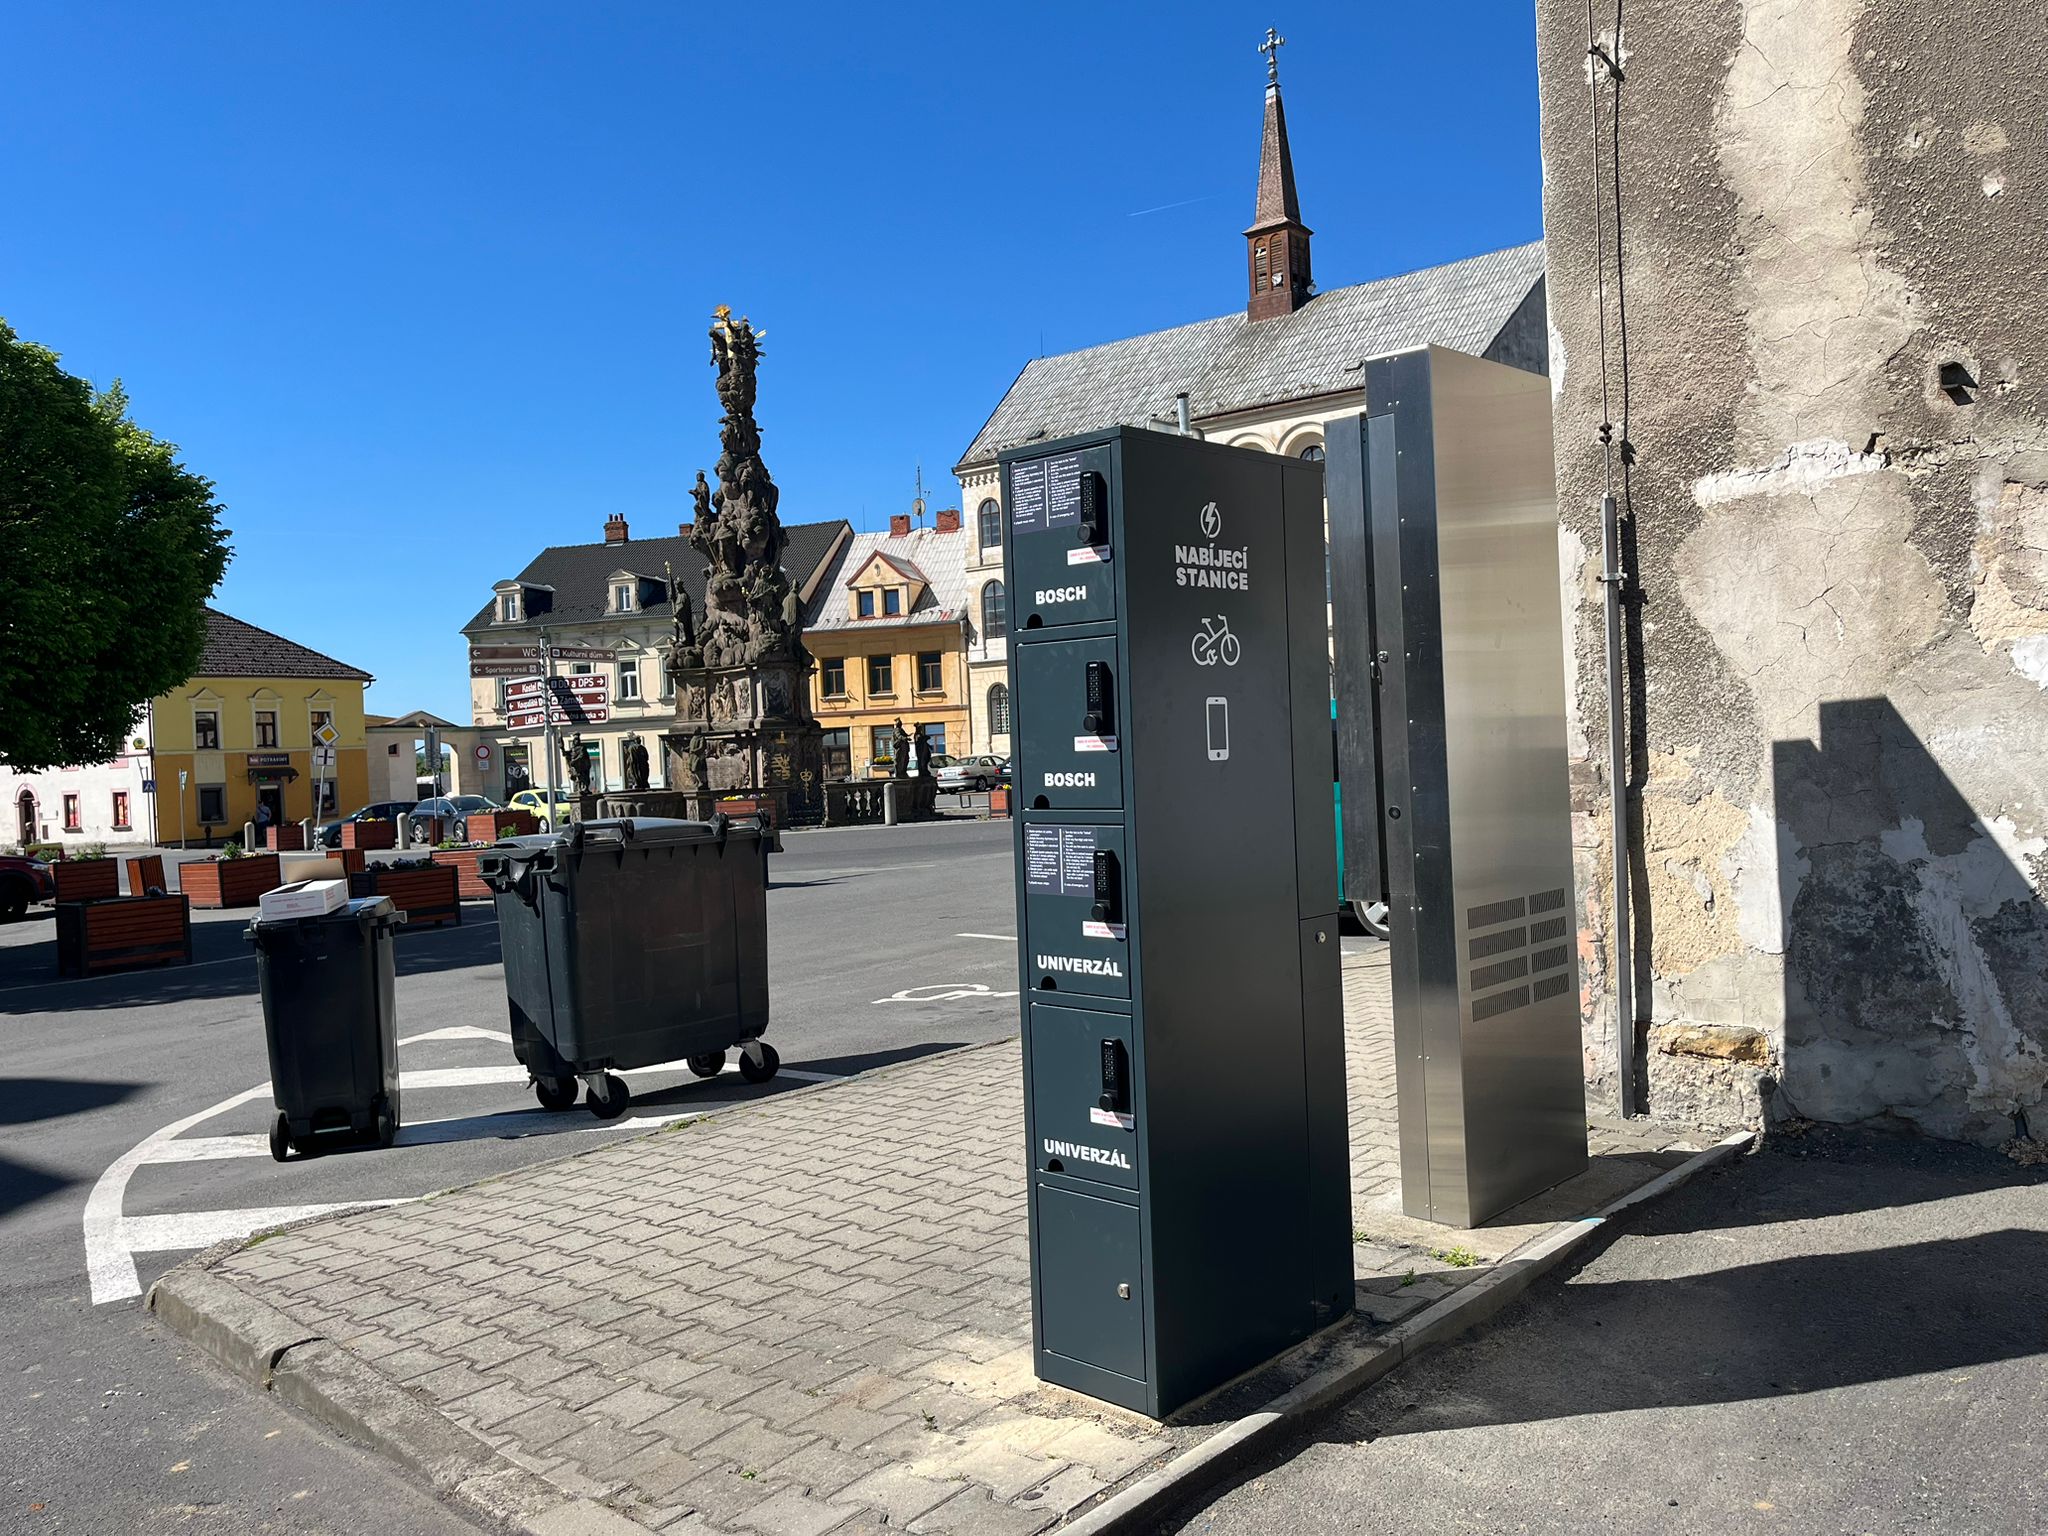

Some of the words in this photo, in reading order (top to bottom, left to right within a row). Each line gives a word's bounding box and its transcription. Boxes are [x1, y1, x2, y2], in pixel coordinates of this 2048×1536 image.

[1174, 543, 1248, 570] NABÍJECÍ
[1175, 567, 1249, 590] STANICE
[1035, 585, 1087, 605] BOSCH
[522, 648, 537, 657] WC
[589, 651, 604, 659] dům
[571, 680, 577, 688] a
[578, 678, 594, 687] DPS
[1044, 772, 1096, 787] BOSCH
[1037, 954, 1123, 977] UNIVERZÁL
[1043, 1138, 1131, 1169] UNIVERZÁL
